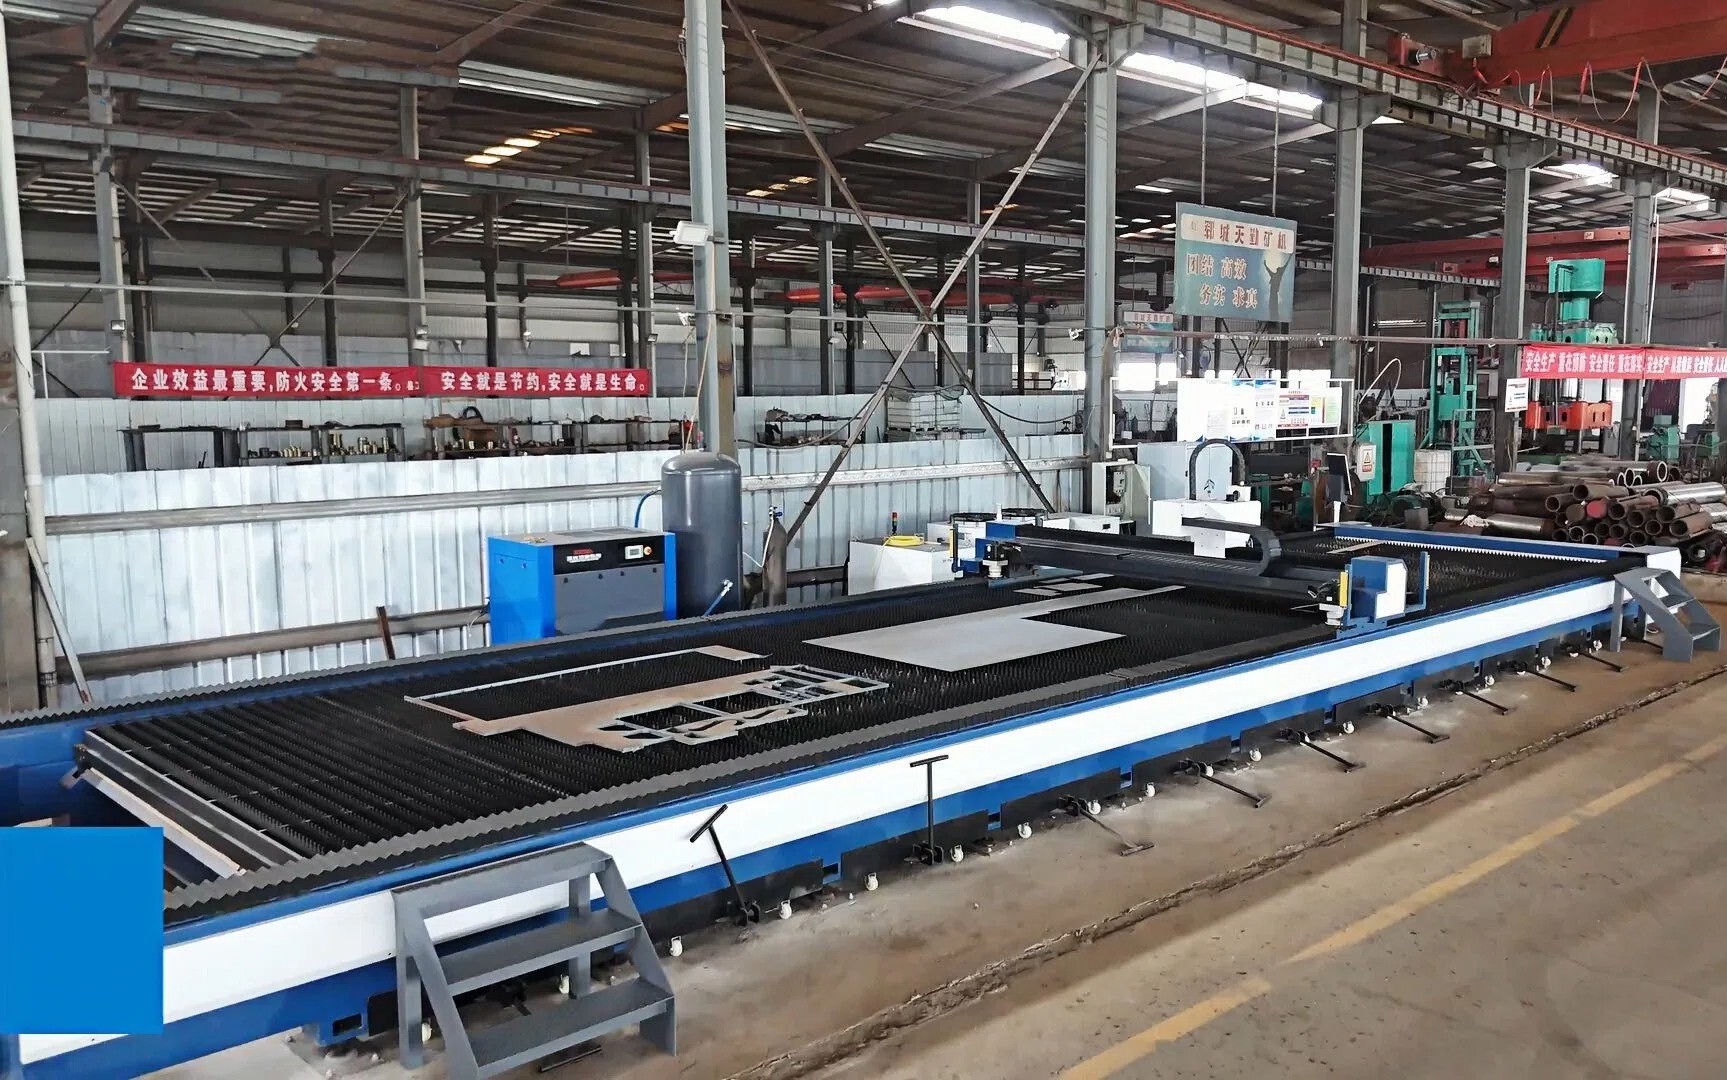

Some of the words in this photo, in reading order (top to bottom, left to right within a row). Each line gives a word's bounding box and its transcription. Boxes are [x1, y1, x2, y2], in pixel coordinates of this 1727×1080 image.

[1186, 252, 1214, 277] 团结
[1221, 256, 1247, 280] 高效
[1200, 283, 1226, 307] 务实
[1232, 286, 1257, 309] 求真
[1525, 351, 1556, 373] 安全生产
